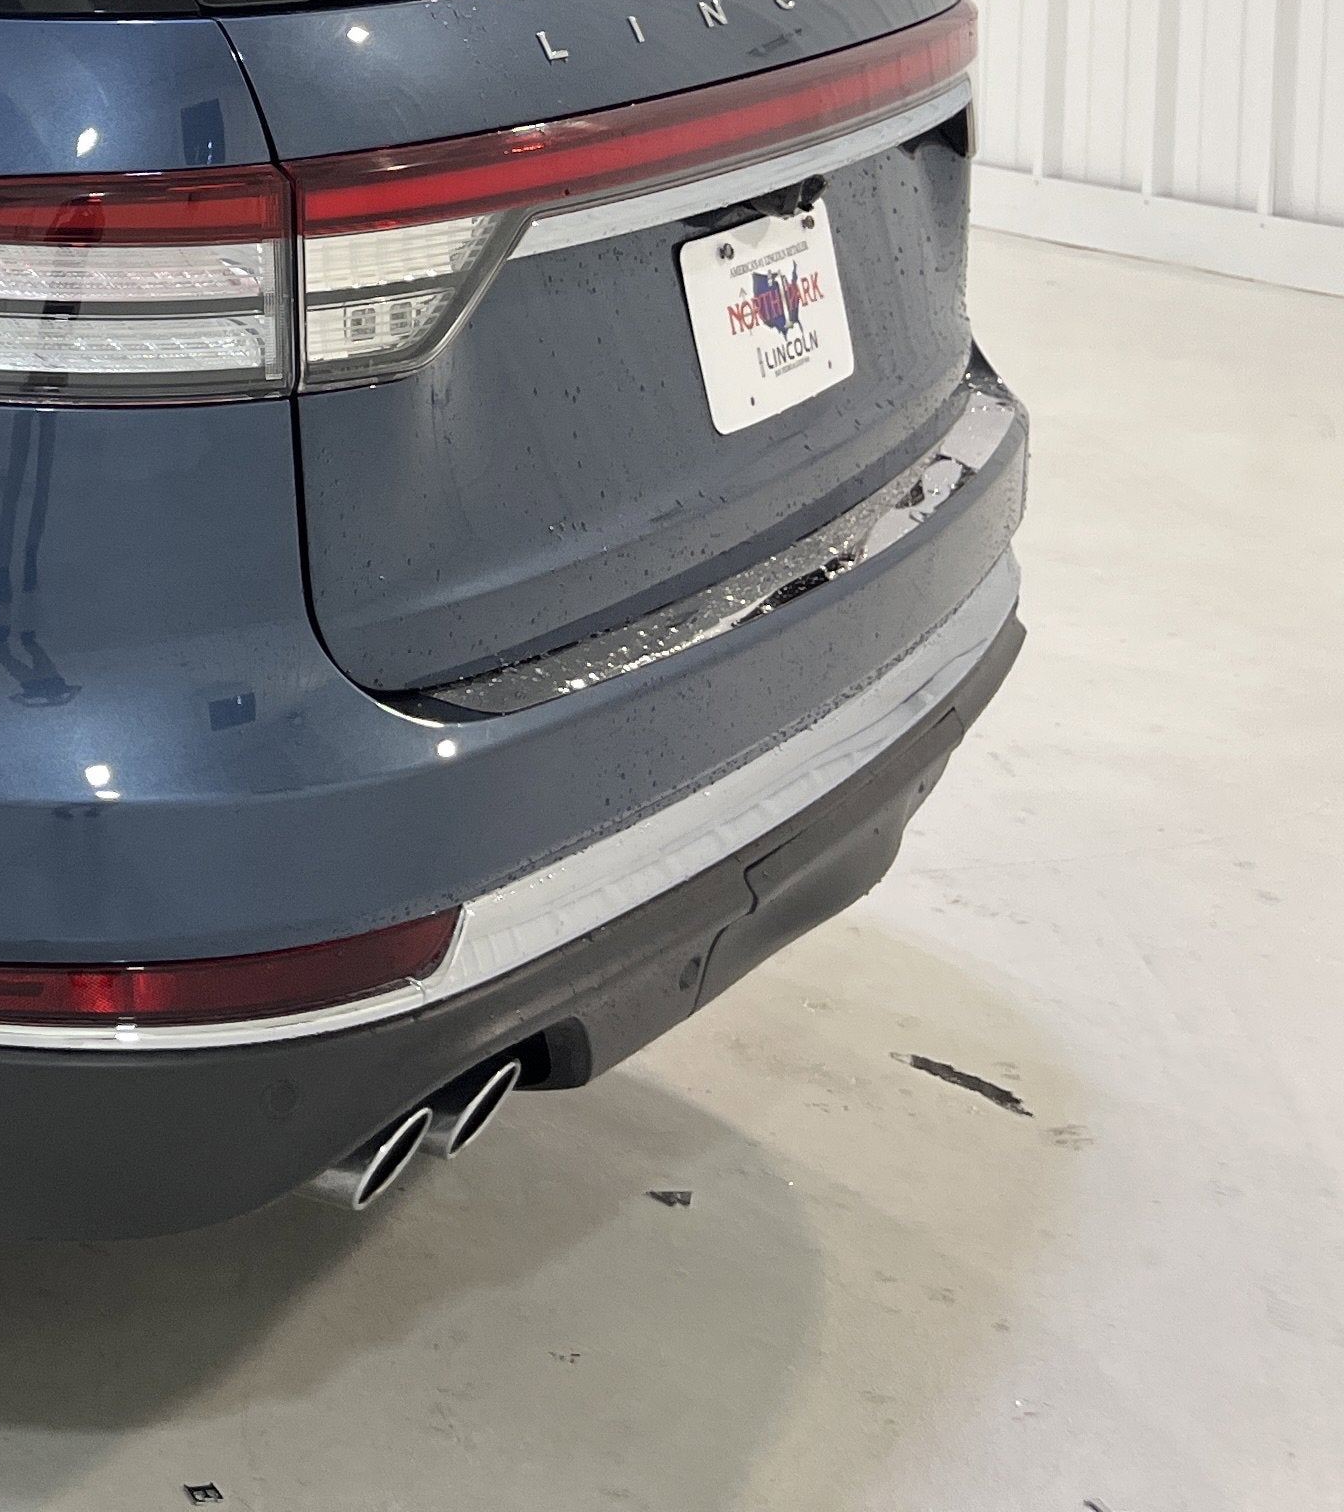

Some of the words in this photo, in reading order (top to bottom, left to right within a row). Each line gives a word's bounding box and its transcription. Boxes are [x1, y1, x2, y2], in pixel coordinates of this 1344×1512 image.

[727, 289, 782, 336] NORTH
[786, 271, 824, 311] PARK
[765, 329, 819, 370] LINCOLN
